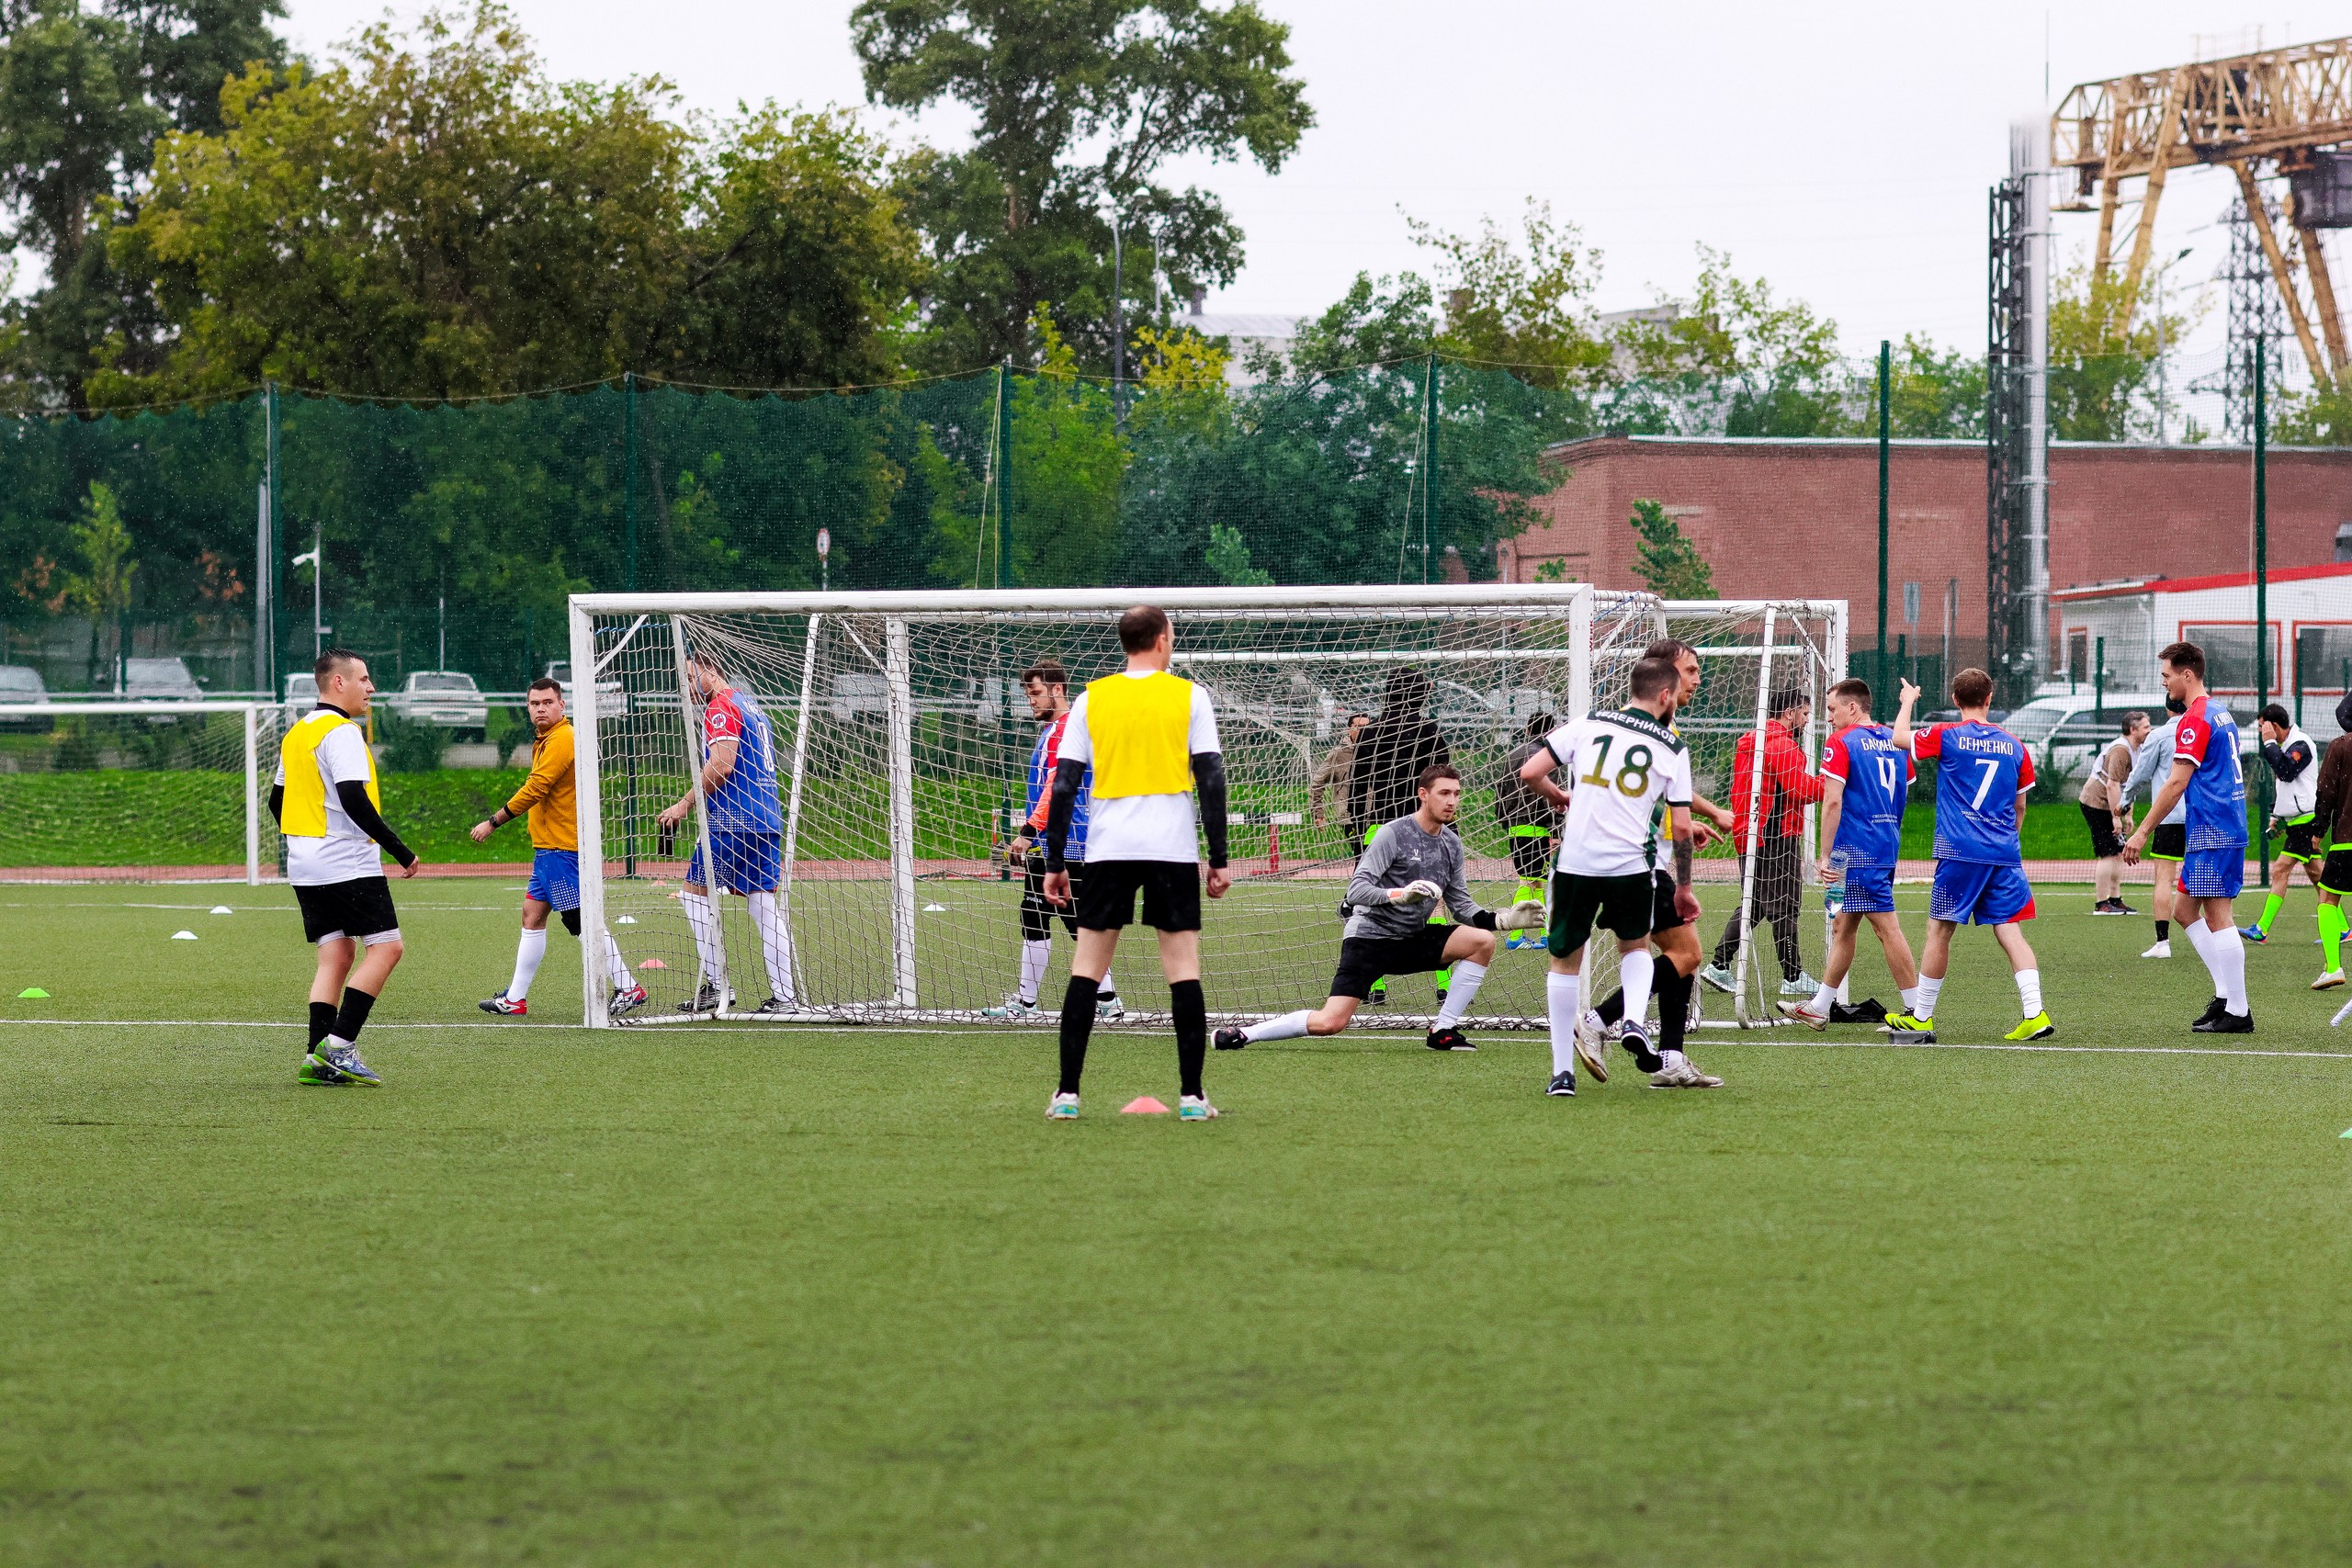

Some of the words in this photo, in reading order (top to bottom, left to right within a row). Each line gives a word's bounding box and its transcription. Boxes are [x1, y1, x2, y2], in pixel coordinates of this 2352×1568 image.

[1580, 734, 1653, 797] 18
[1959, 736, 2014, 756] СЕНЧЕНКО
[1971, 758, 2000, 811] 7
